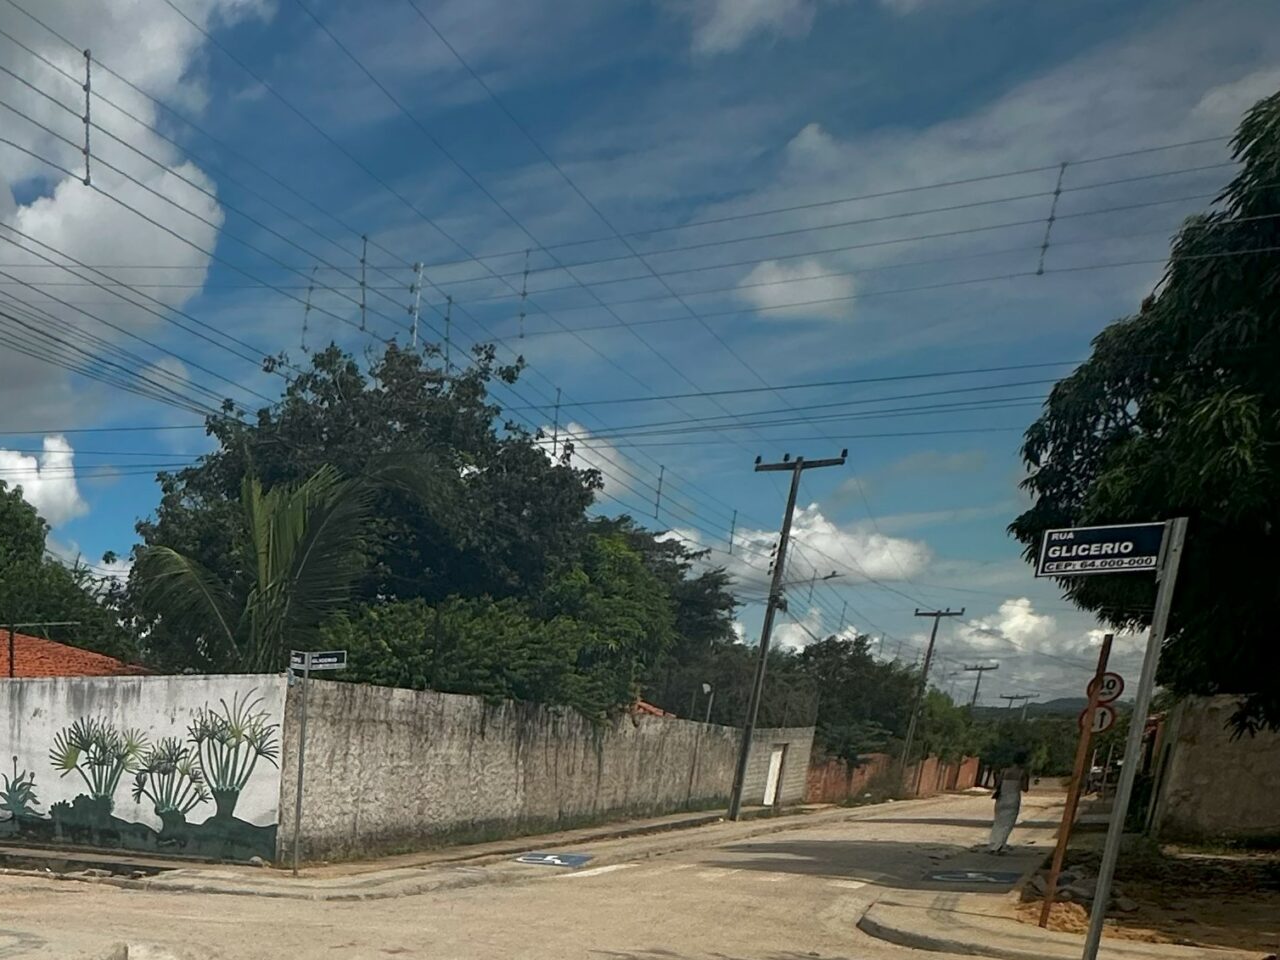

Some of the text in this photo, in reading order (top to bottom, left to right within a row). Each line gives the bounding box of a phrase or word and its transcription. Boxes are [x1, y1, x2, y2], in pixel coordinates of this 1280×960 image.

[1051, 532, 1074, 541] RUA
[1048, 541, 1134, 558] GLICERIO
[1046, 557, 1153, 571] CEP: 64.000-000
